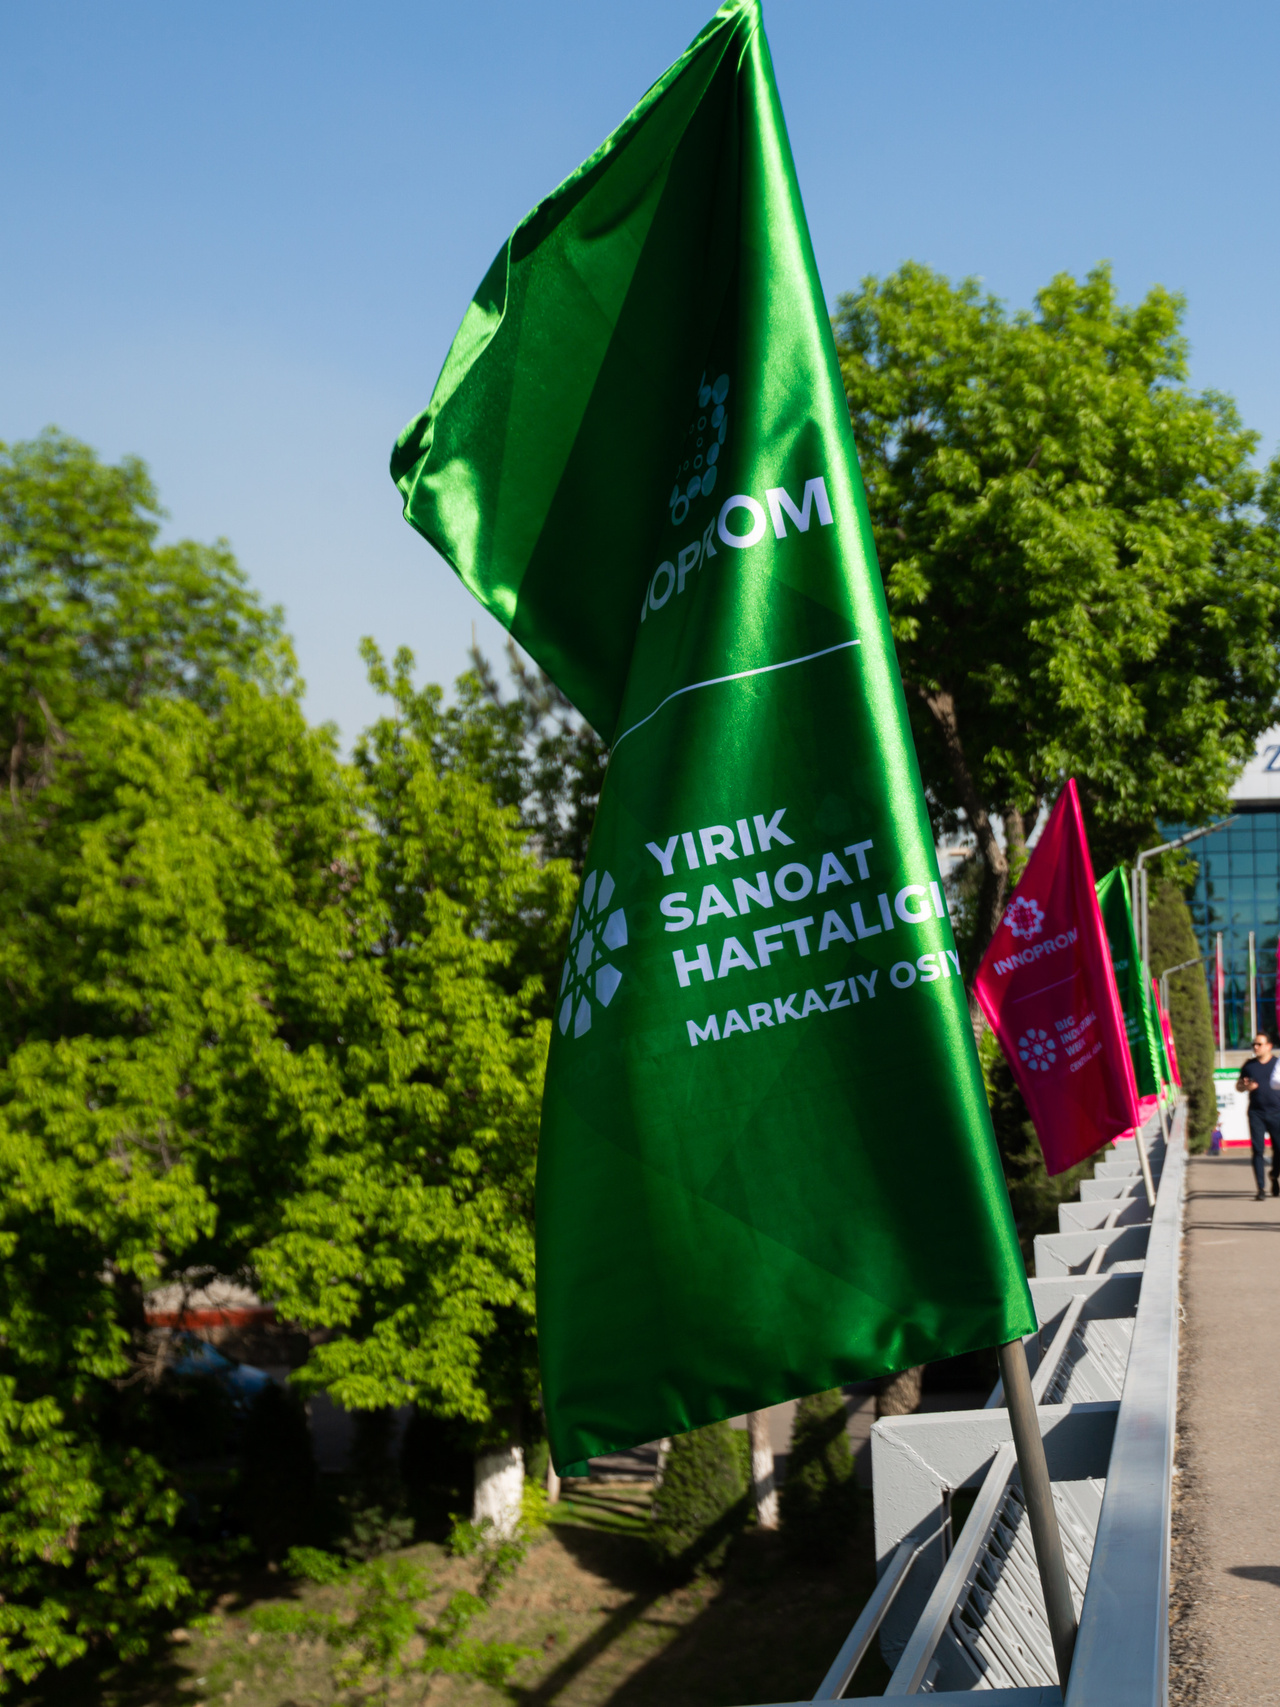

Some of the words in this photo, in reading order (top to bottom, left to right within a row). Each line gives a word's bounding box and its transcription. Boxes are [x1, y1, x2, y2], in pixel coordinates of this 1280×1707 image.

[641, 476, 834, 624] OPROM
[645, 807, 796, 877] YIRIK
[659, 839, 874, 932] SANOAT
[672, 881, 946, 988] HAFTALIGI
[686, 969, 879, 1047] MARKAZIY
[1054, 1015, 1076, 1031] BIG
